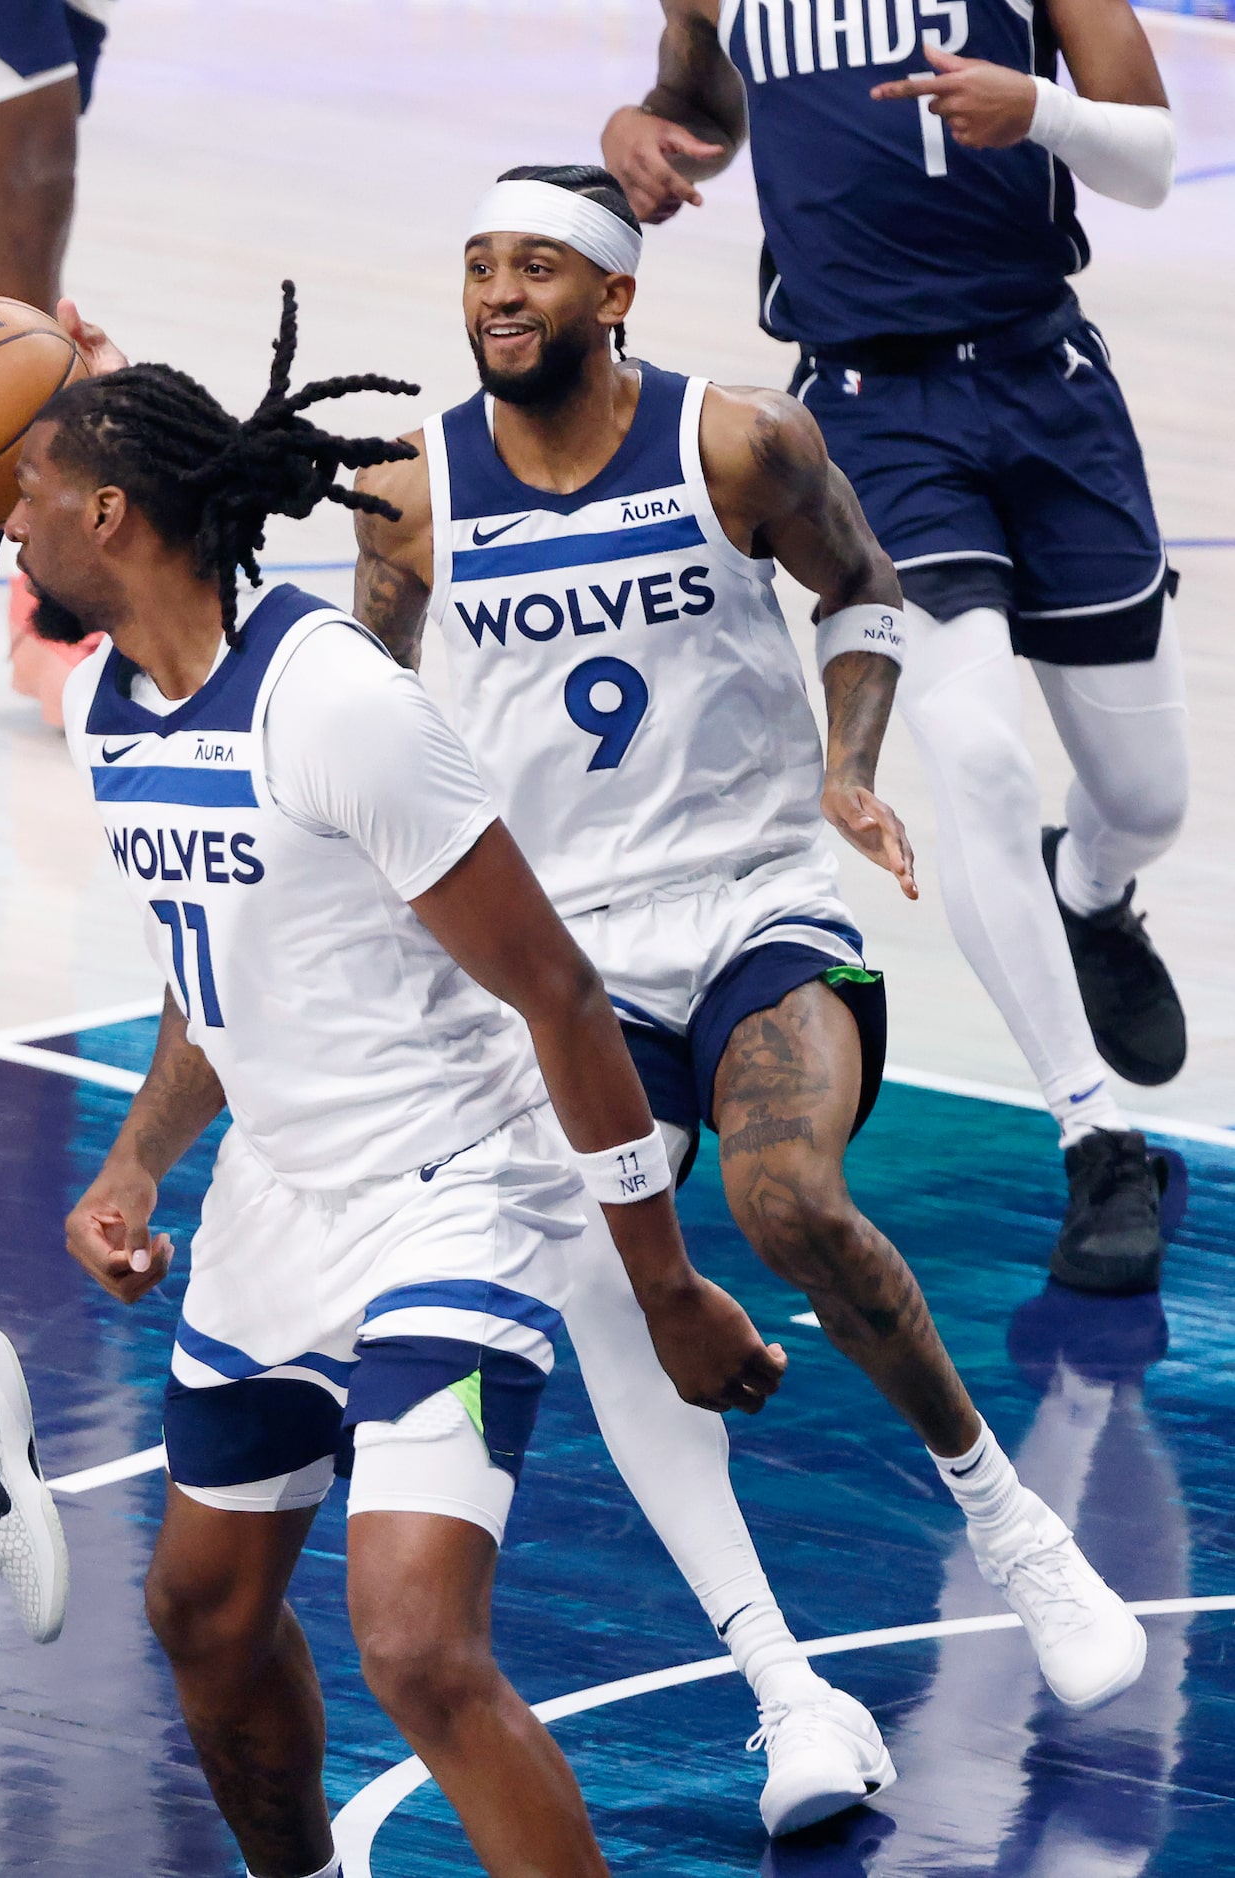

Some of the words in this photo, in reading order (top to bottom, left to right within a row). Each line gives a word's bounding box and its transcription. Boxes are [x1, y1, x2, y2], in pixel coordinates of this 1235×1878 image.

[908, 71, 948, 178] 1
[454, 565, 716, 648] WOLVES
[880, 615, 894, 631] 9
[863, 629, 903, 646] NAW
[563, 656, 649, 773] 9
[104, 827, 265, 885] WOLVES
[148, 899, 226, 1029] 11
[615, 1151, 639, 1175] 11
[619, 1174, 648, 1197] NR
